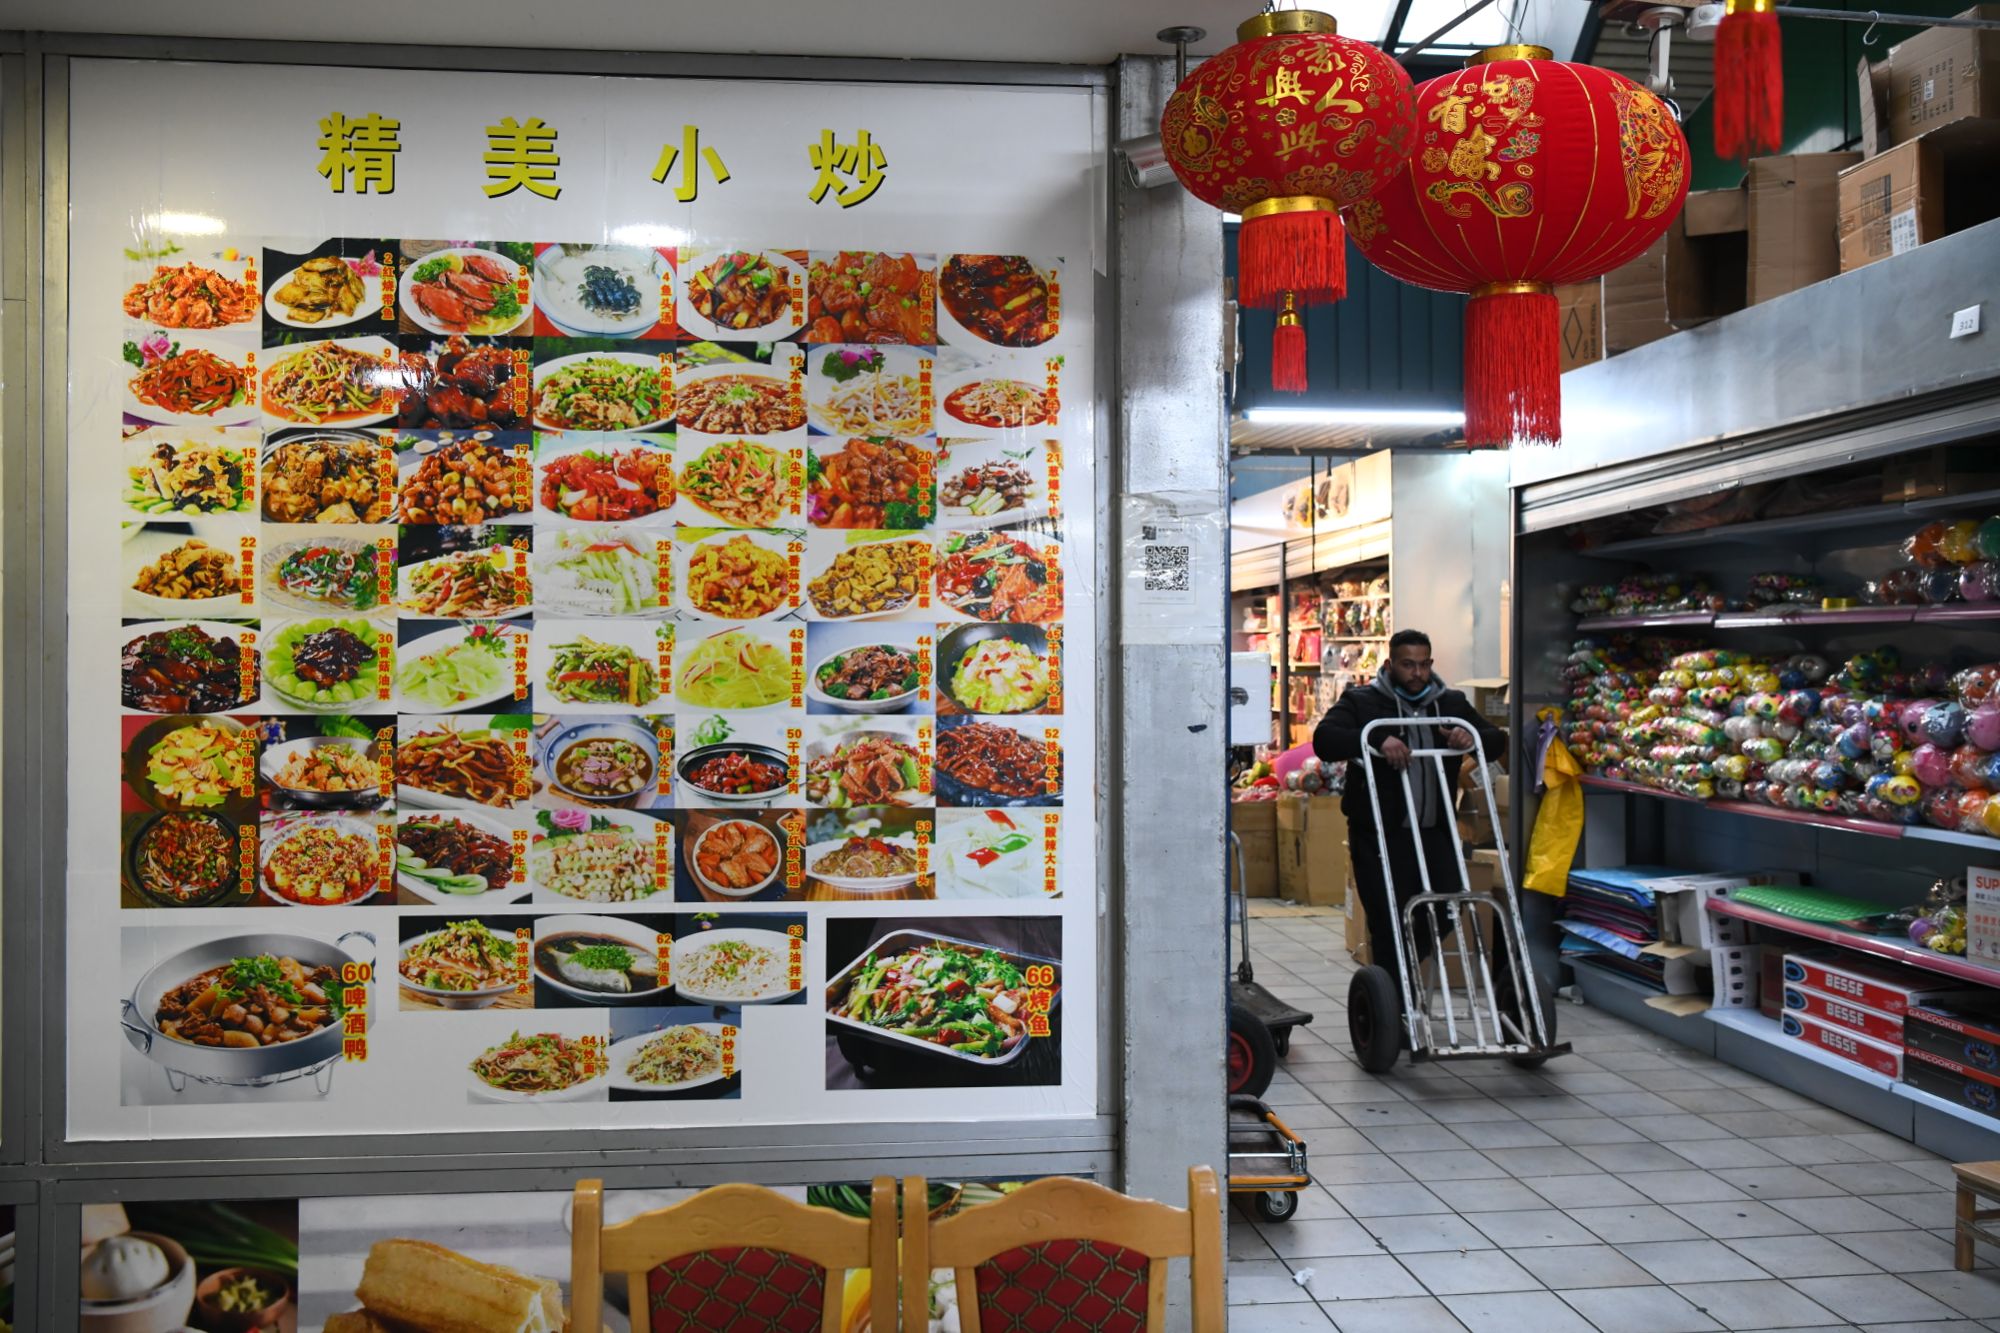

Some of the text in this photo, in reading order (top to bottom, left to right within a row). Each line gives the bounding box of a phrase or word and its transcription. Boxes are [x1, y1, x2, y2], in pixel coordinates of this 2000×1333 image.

[317, 112, 888, 208] 精美小炒
[1825, 973, 1864, 997] BESSE
[1826, 1002, 1864, 1027] BESSE
[1821, 1030, 1857, 1055] BESSE
